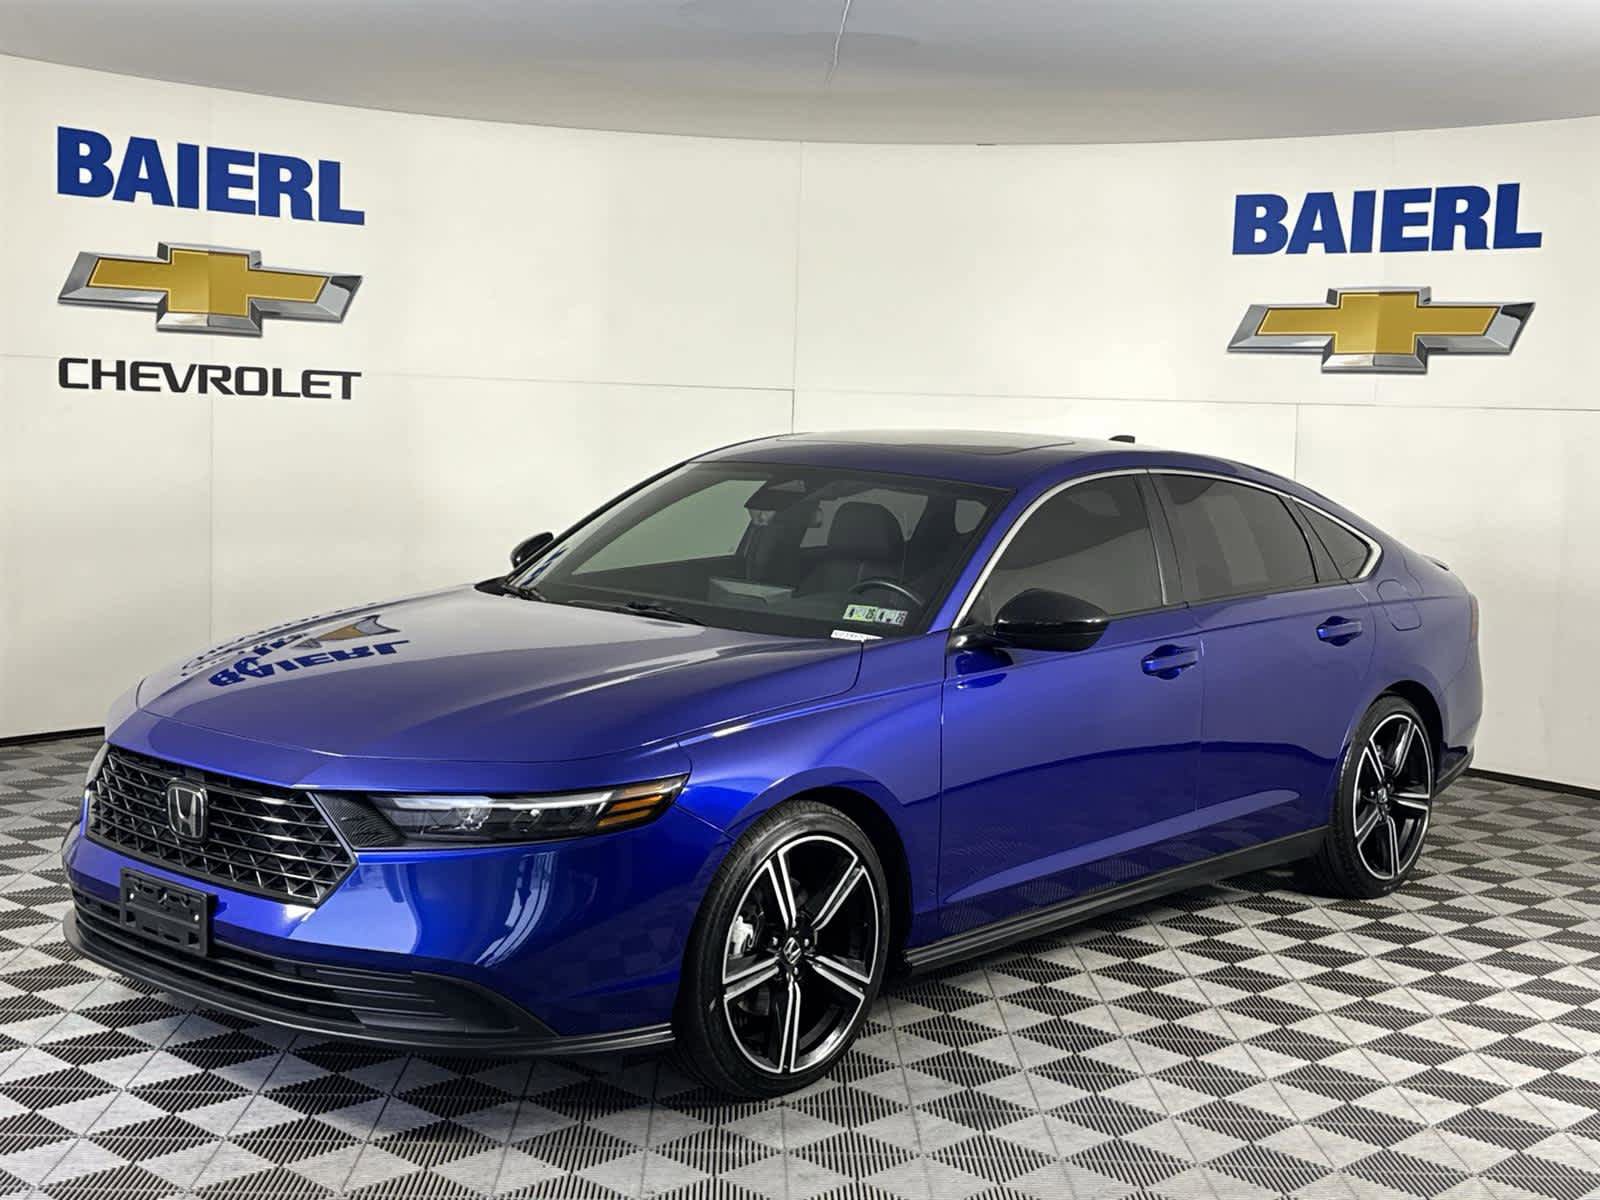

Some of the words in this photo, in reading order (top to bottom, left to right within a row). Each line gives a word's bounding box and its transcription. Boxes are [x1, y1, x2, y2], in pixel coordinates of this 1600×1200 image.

[58, 127, 364, 225] BAIERL
[1232, 183, 1541, 253] BAIERL
[58, 357, 362, 400] CHEVROLET
